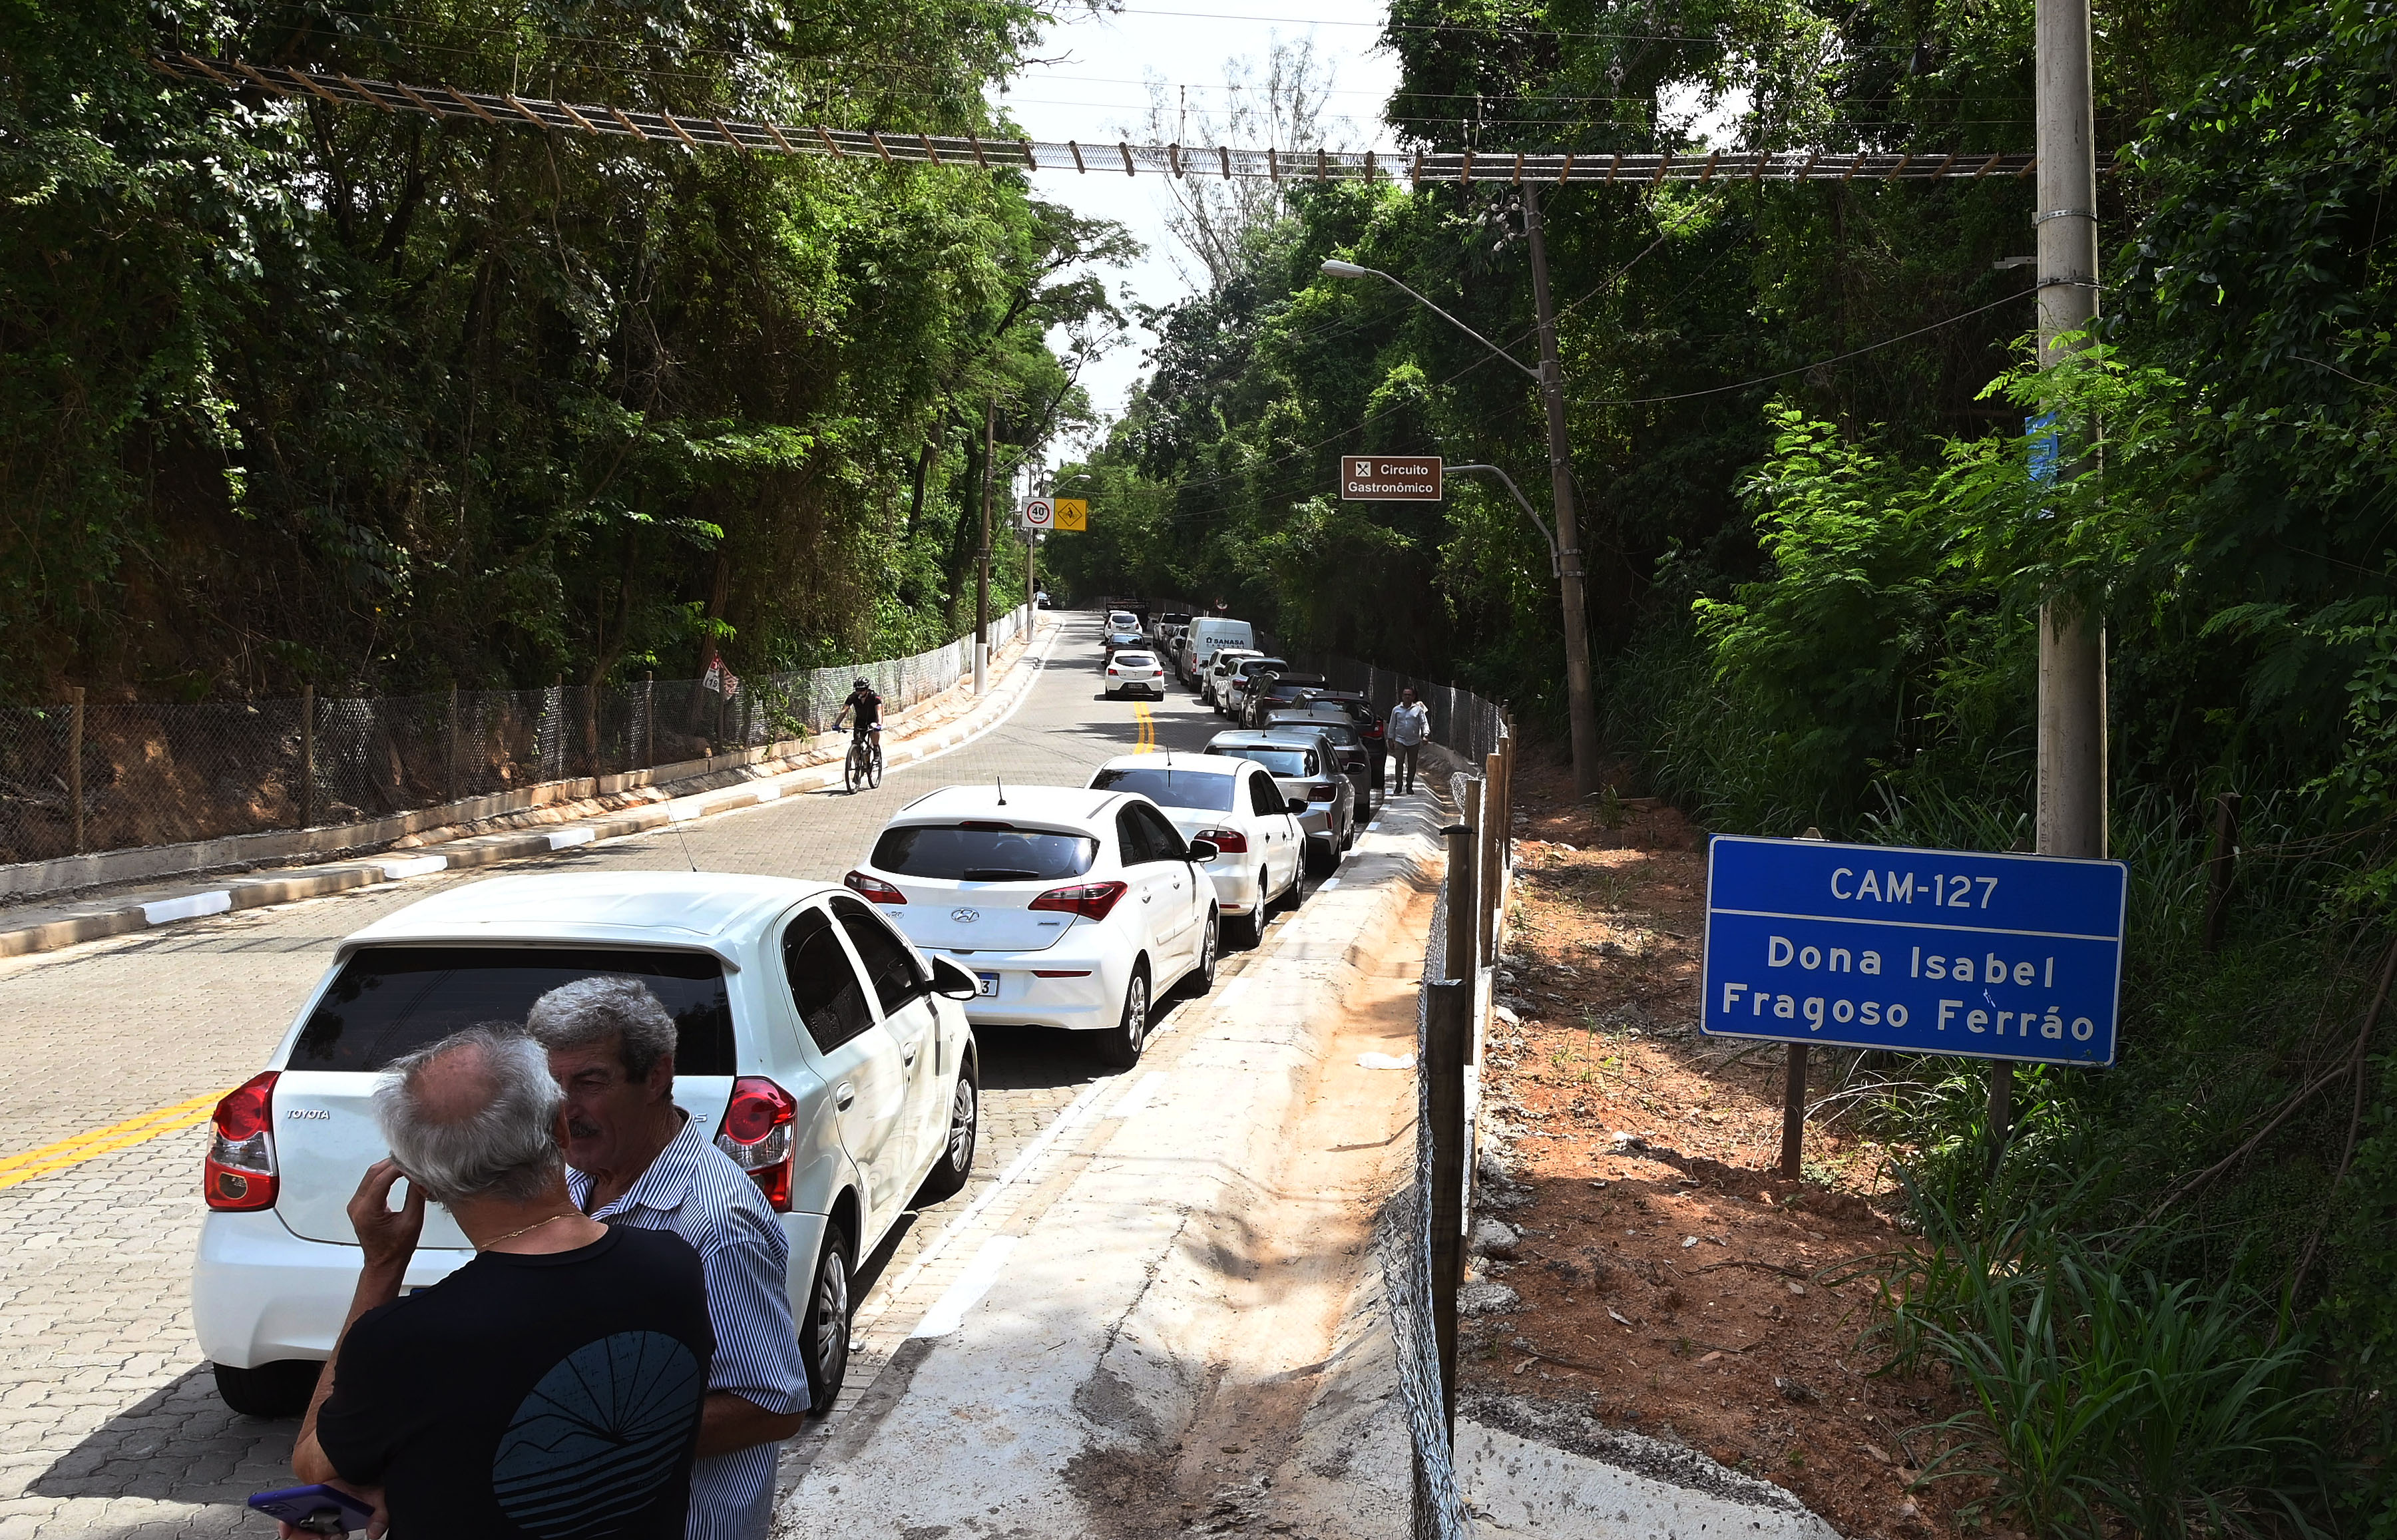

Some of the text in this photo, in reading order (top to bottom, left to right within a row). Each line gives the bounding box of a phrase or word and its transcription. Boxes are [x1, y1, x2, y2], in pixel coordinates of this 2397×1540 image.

[1381, 464, 1428, 475] Circuito
[1348, 481, 1433, 492] Gastronômico
[1032, 506, 1044, 516] 40
[1831, 868, 1999, 909] CAM-127
[1768, 935, 2054, 988] Dona Isabel
[1723, 982, 2093, 1041] Fragoso Ferráo
[287, 1109, 330, 1120] TOYOTA
